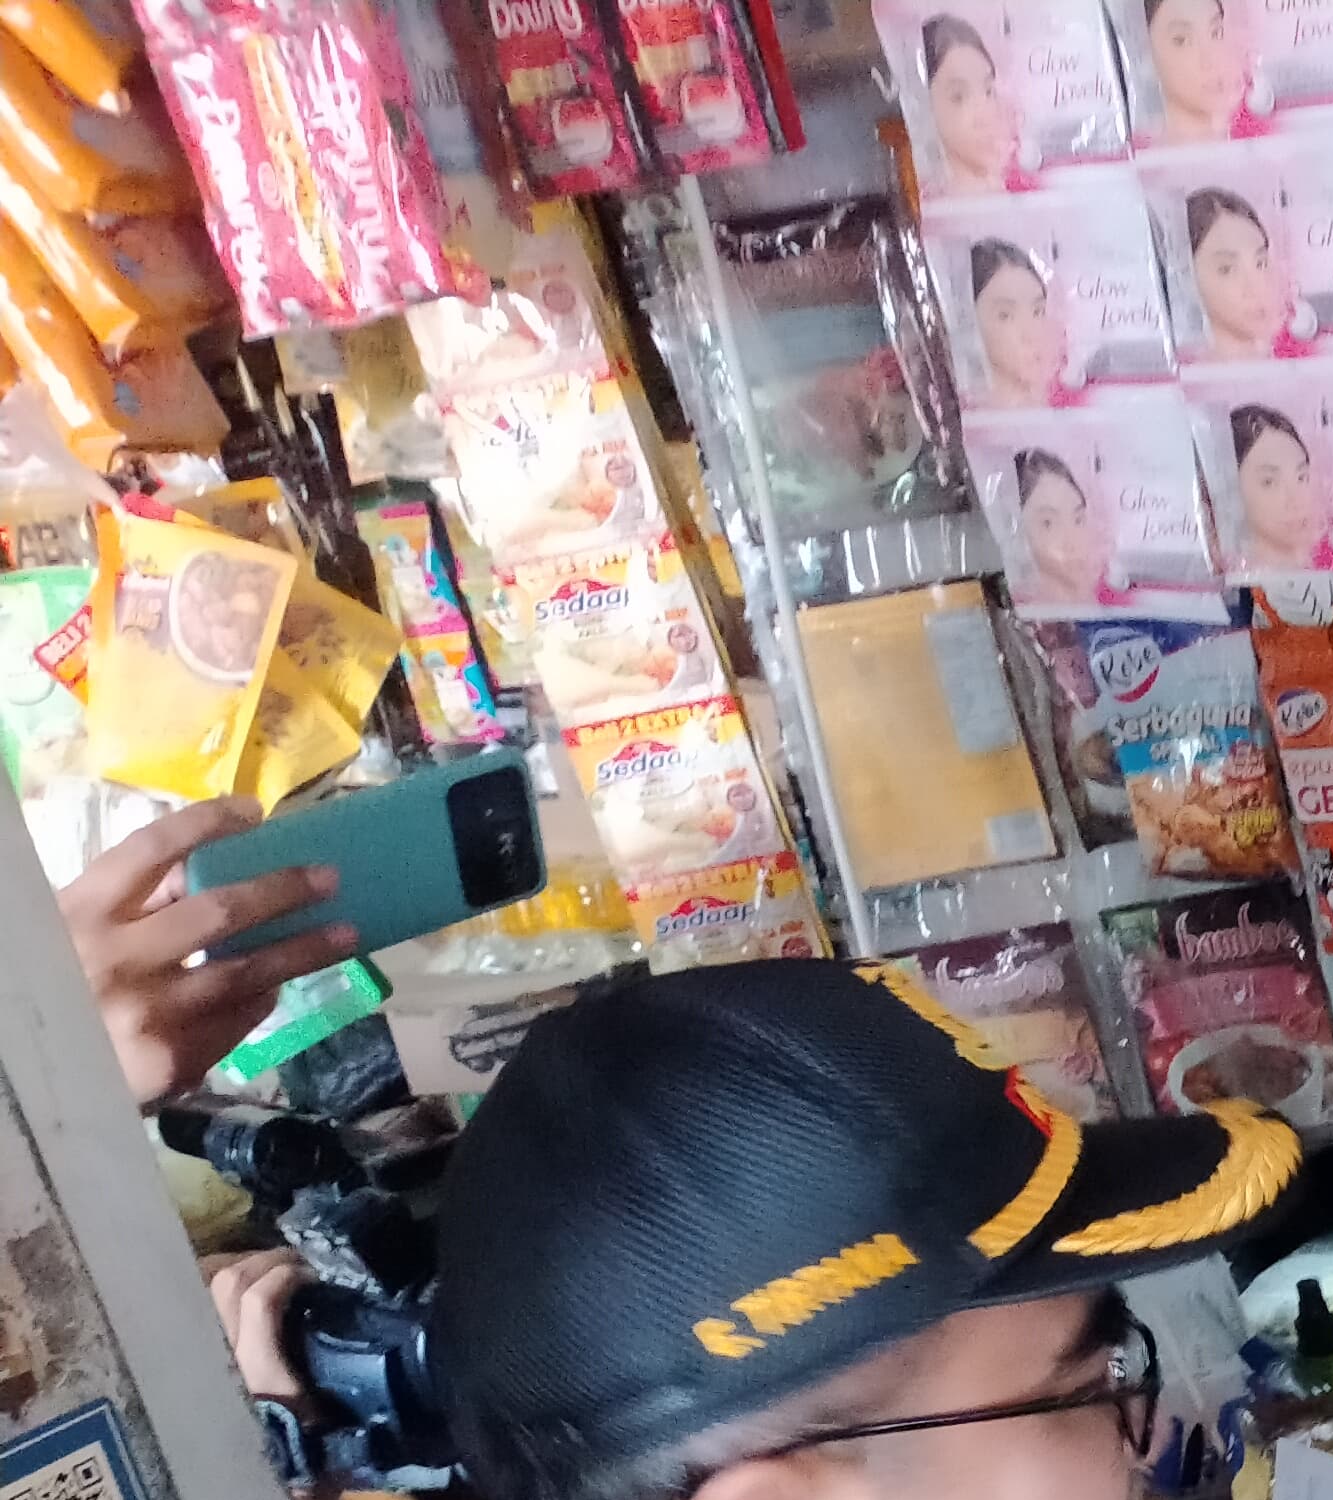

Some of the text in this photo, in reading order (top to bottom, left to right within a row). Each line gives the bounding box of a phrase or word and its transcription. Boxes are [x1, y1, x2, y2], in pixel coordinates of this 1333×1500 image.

[1028, 48, 1080, 75] Glow
[1076, 276, 1130, 300] Glow
[1120, 487, 1169, 512] Glow
[1143, 515, 1198, 543] Lovely
[1106, 703, 1251, 747] Serbaguna
[656, 903, 751, 934] Sedaap
